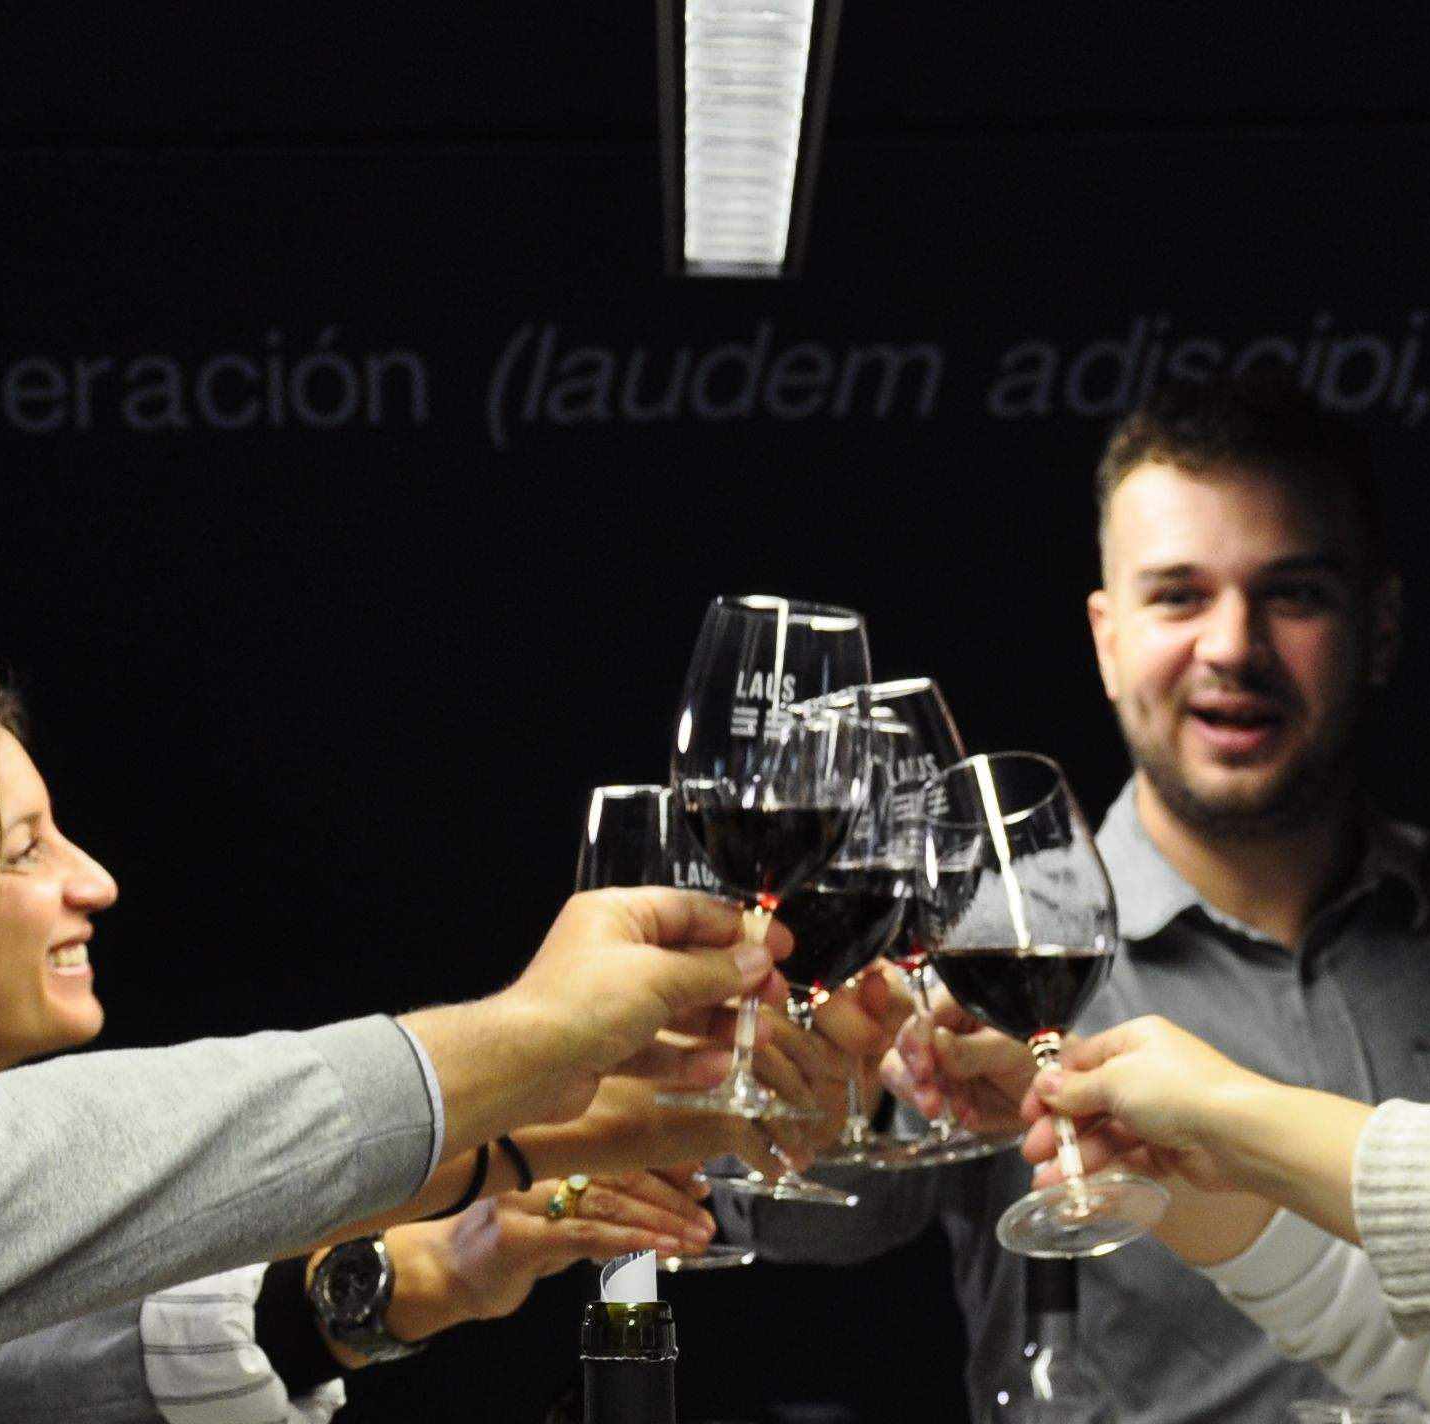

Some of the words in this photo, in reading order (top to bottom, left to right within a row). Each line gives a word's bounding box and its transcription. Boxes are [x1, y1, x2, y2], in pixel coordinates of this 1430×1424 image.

[485, 318, 945, 450] (laudem
[735, 670, 797, 703] LAUS
[673, 861, 721, 888] LAU
